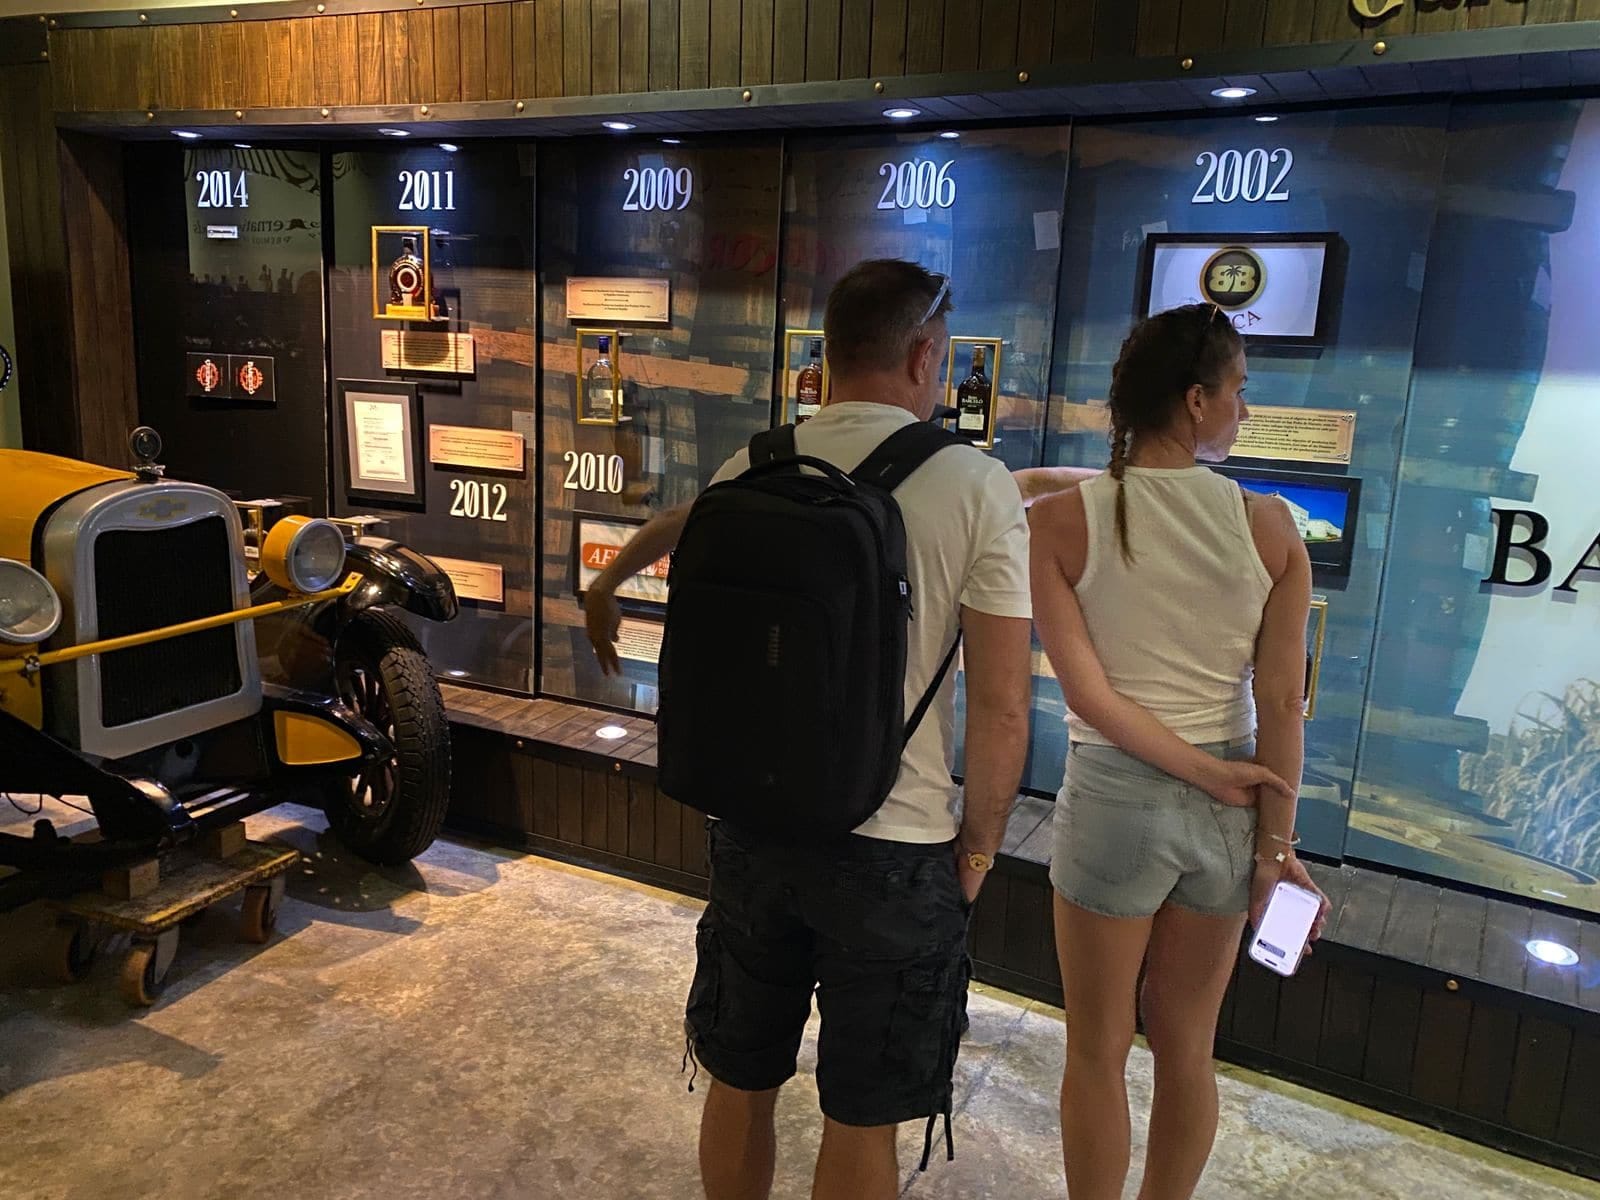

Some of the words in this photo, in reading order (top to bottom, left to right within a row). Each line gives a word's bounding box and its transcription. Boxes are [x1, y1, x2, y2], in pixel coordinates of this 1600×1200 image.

[196, 170, 249, 208] 2014
[398, 170, 456, 211] 2011
[622, 167, 692, 211] 2009
[877, 159, 956, 209] 2006
[1191, 148, 1293, 203] 2002
[563, 450, 624, 494] 2010
[449, 479, 507, 522] 2012
